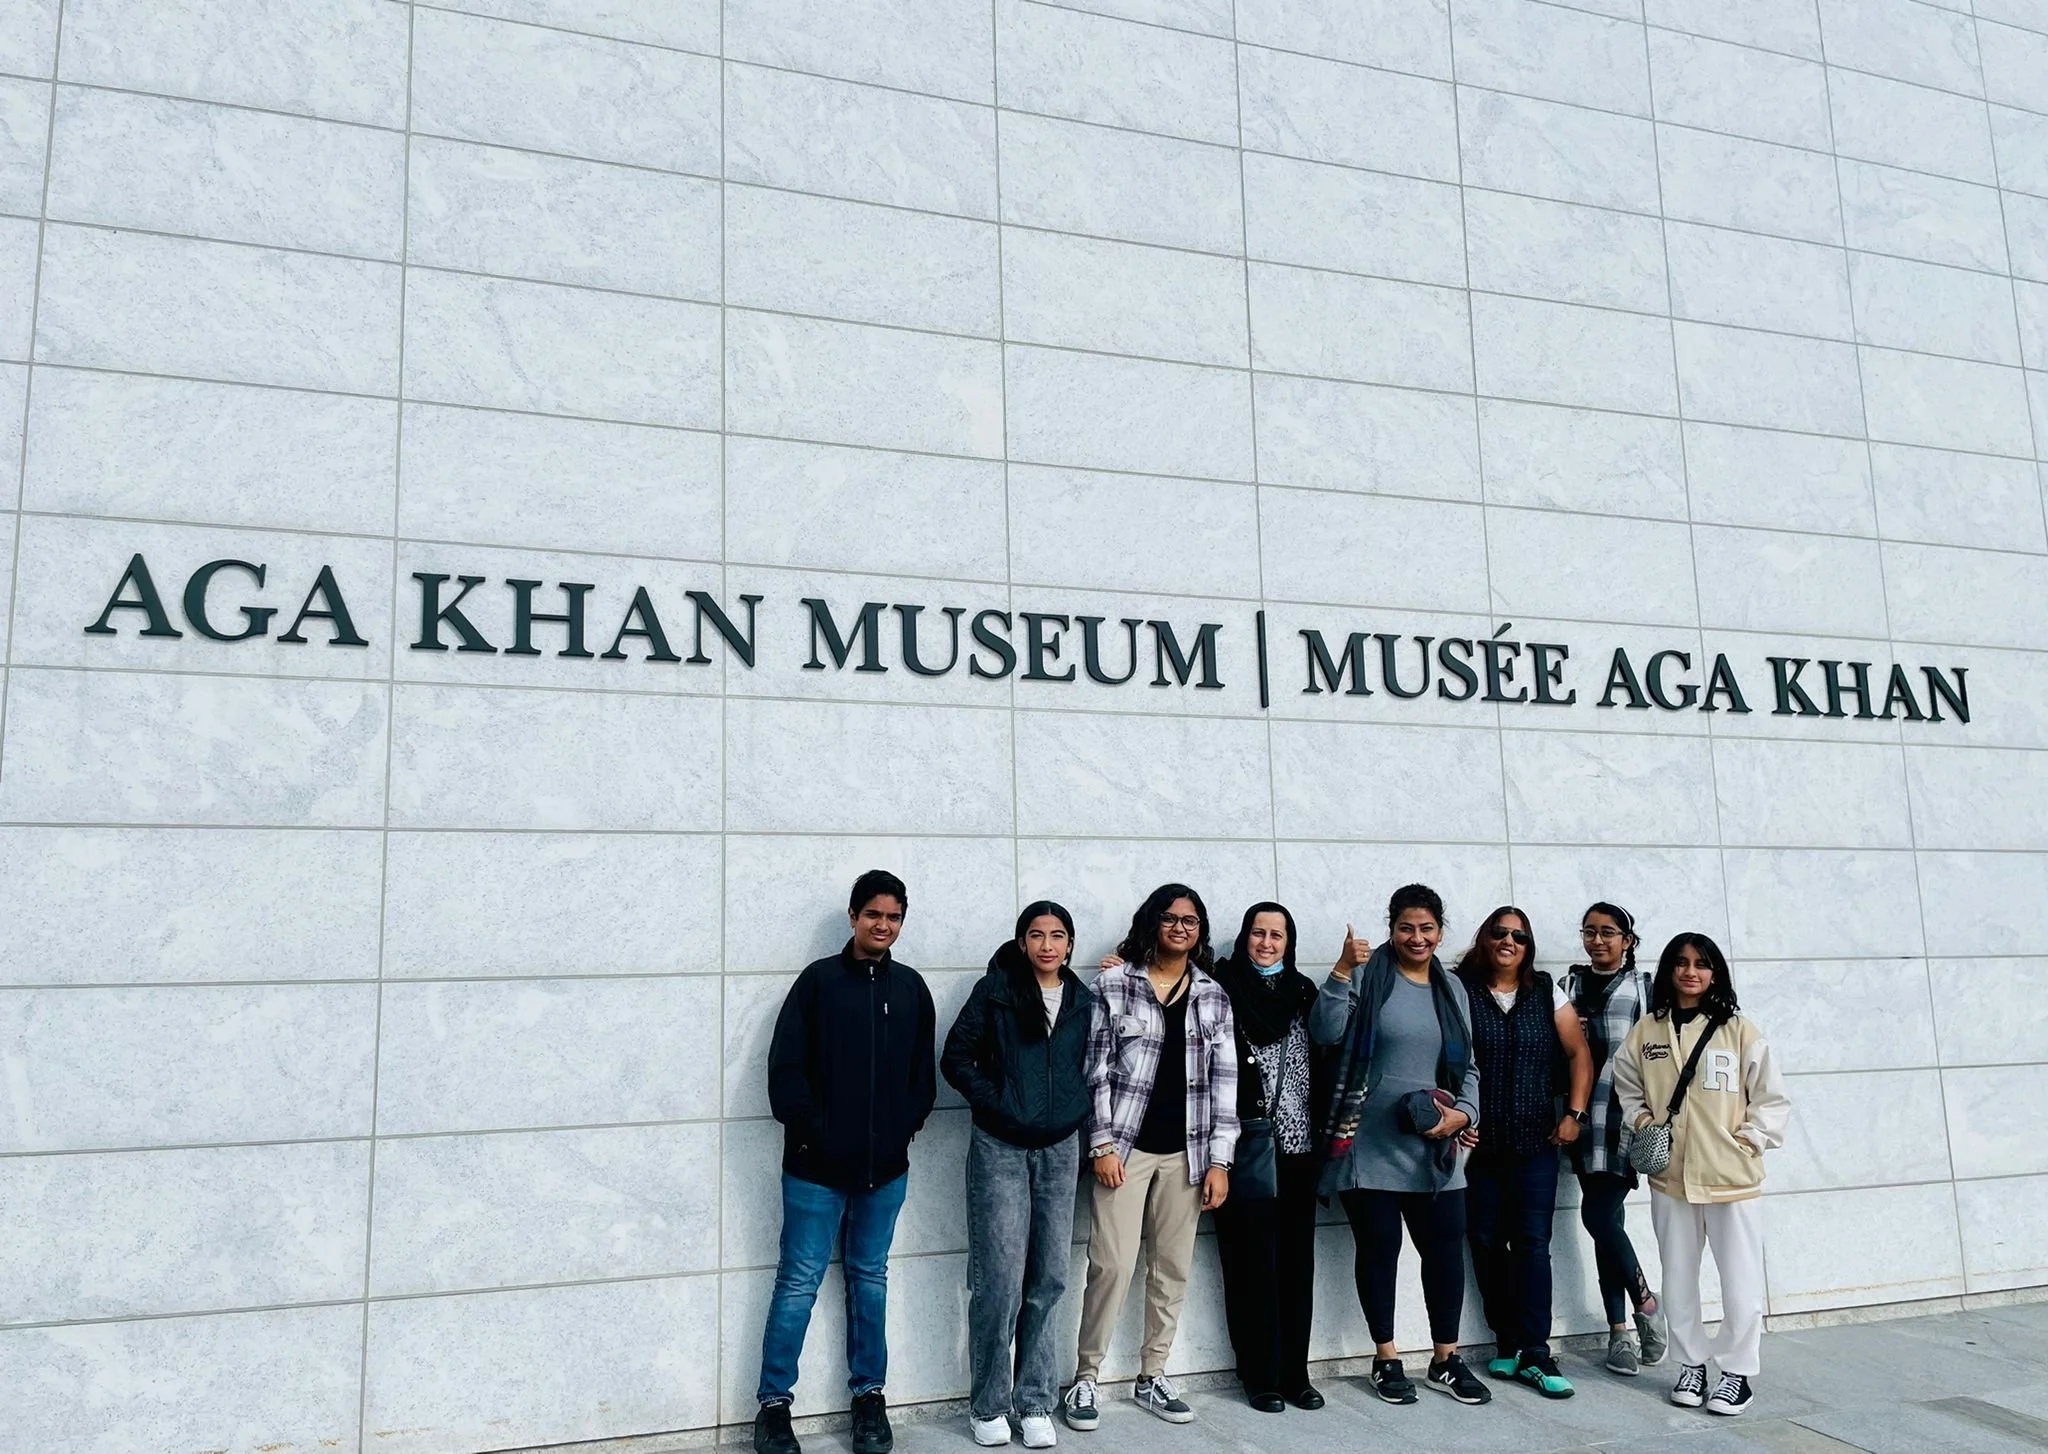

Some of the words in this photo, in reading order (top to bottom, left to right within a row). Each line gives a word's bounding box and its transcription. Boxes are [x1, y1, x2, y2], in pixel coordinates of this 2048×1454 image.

[83, 552, 370, 648] AGA
[410, 572, 765, 669] KHAN
[800, 597, 1226, 690] MUSEUM
[1298, 622, 1577, 706] MUSÉE
[1596, 647, 1753, 714] AGA
[1765, 656, 1972, 725] KHAN
[1703, 1049, 1739, 1094] R
